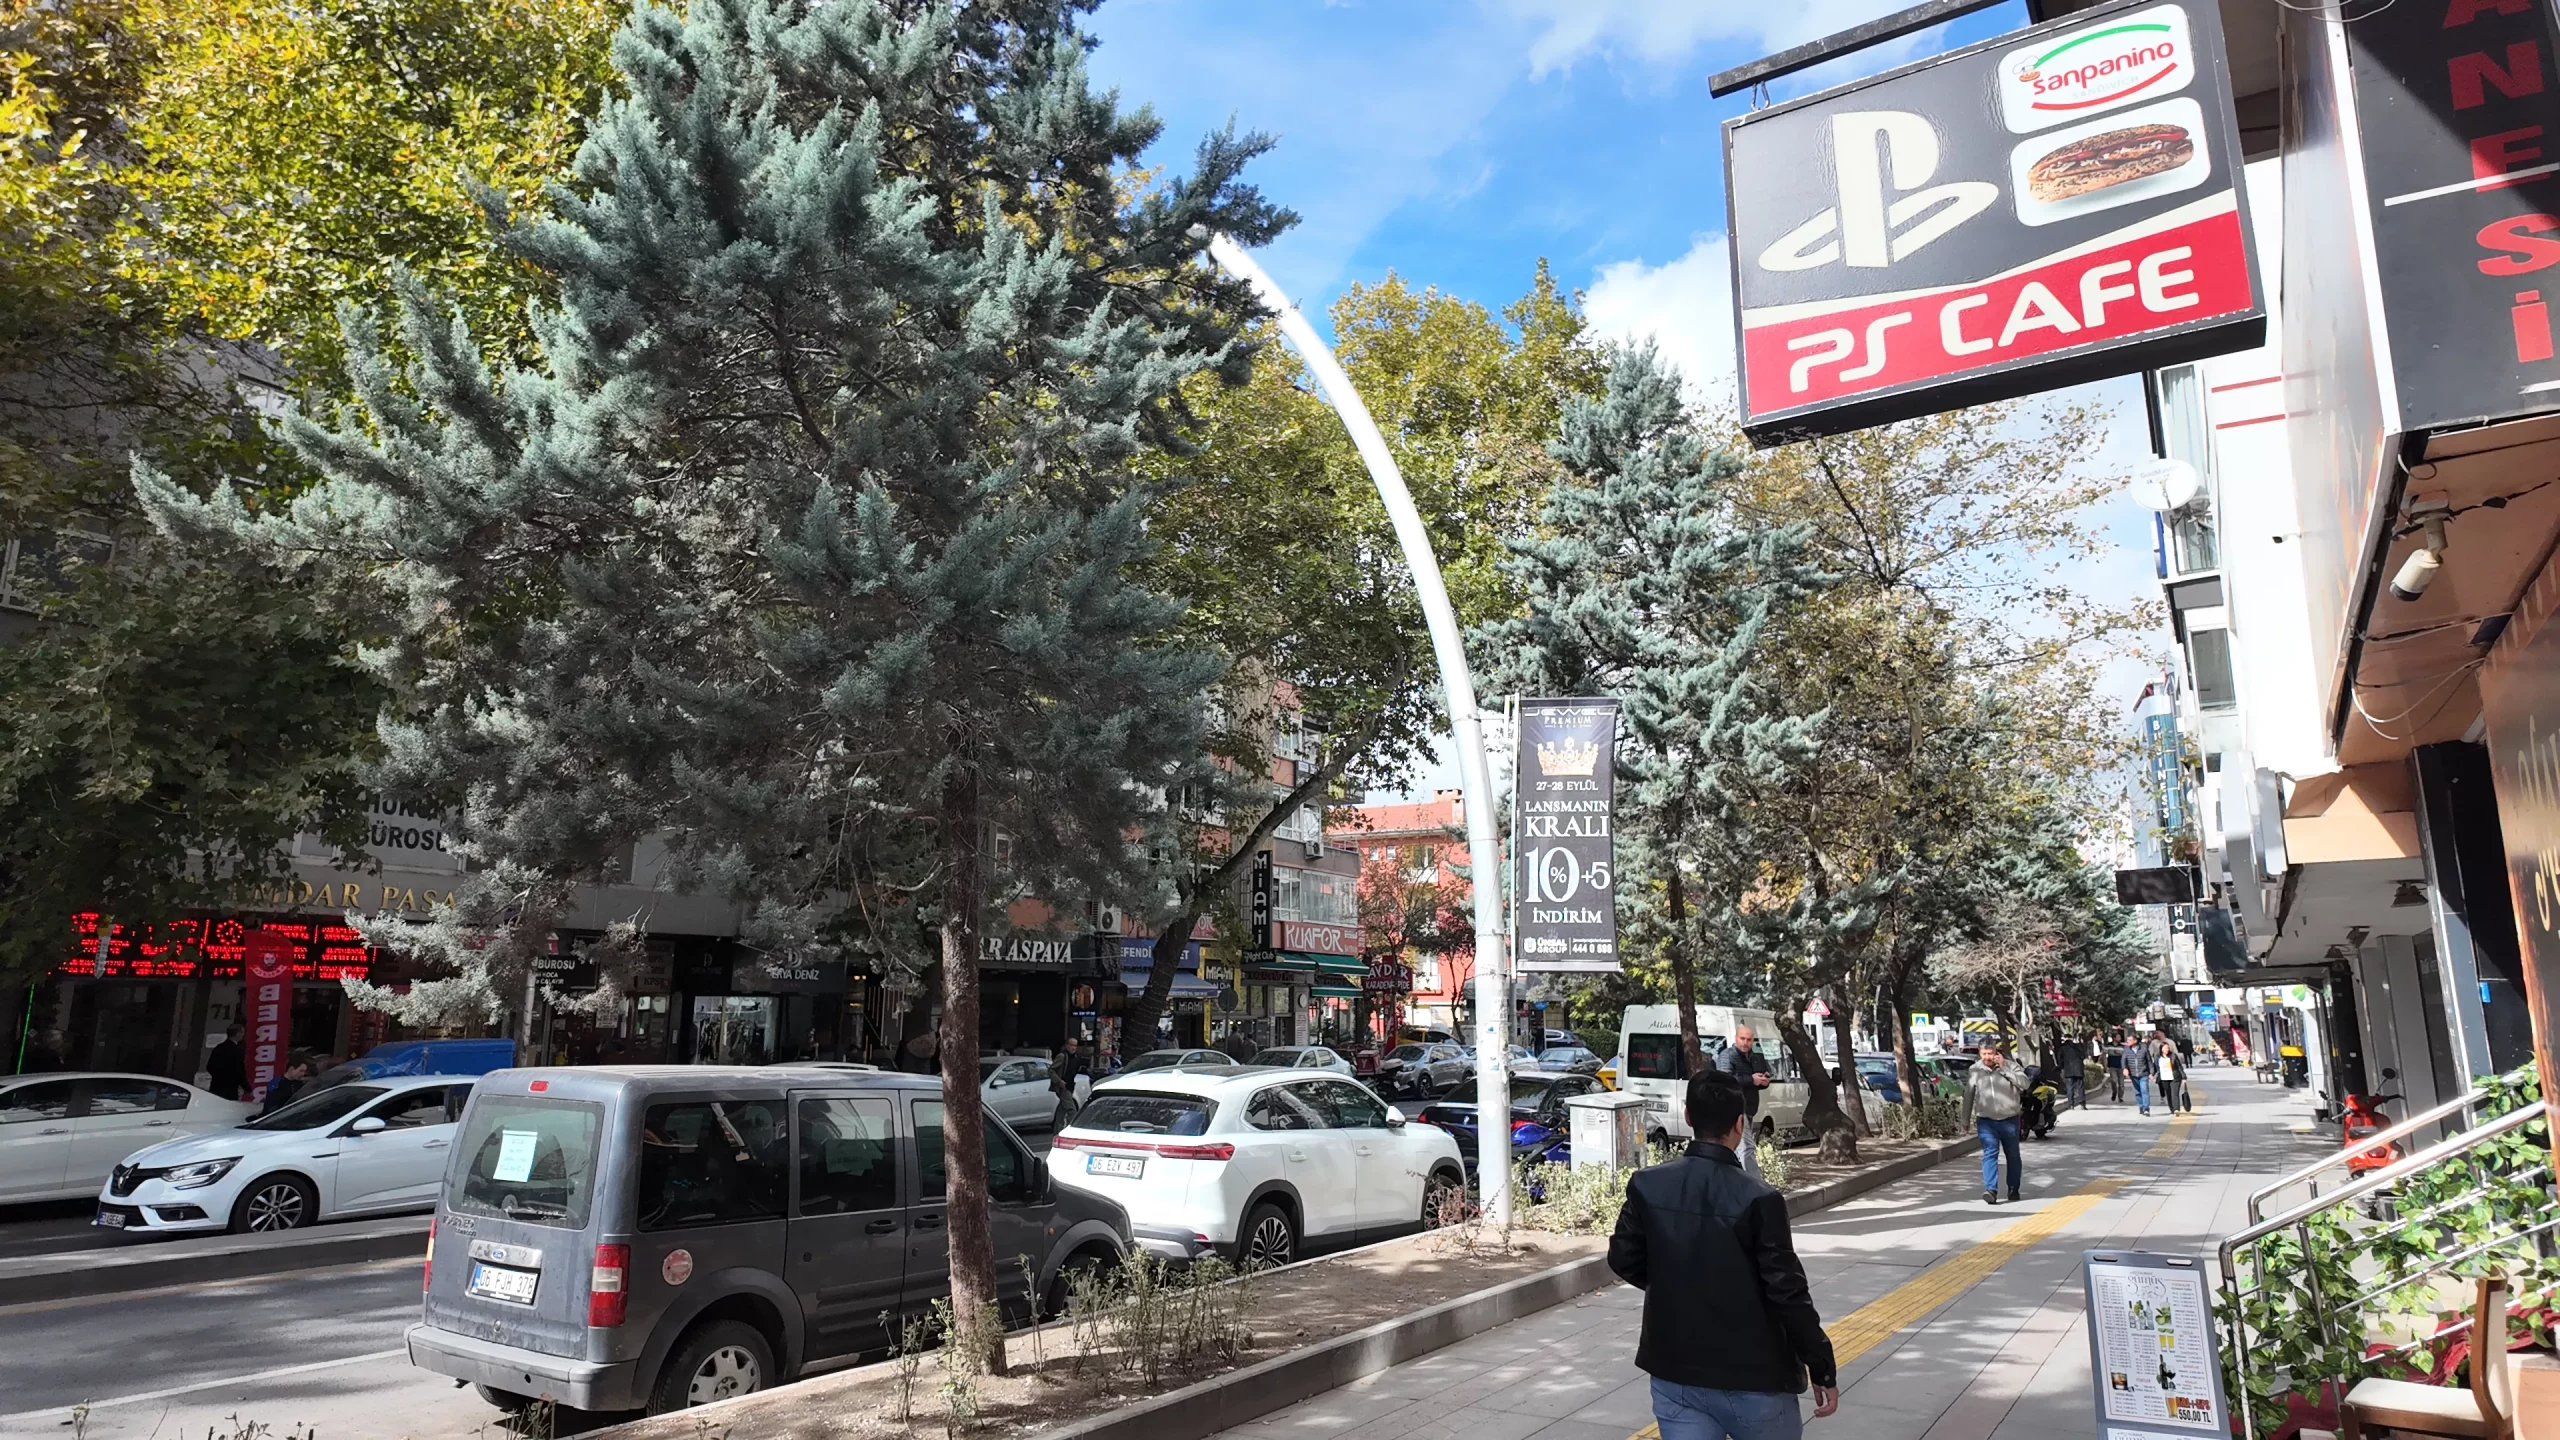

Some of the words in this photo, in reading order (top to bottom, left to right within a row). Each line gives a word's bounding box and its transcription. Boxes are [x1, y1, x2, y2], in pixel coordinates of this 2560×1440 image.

[2033, 42, 2175, 96] sanpanino
[2072, 75, 2140, 100] SANDWICH
[1787, 311, 1912, 393] PS
[1939, 245, 2200, 357] CAFE
[1524, 708, 1614, 717] JEWEL
[1544, 716, 1593, 725] PREMIUM
[1536, 781, 1564, 791] 27-28
[1566, 779, 1599, 791] EYLÜL
[1525, 801, 1610, 813] LANSMANIN
[1525, 815, 1610, 838] KRALI
[1524, 846, 1580, 903] 10
[1581, 861, 1611, 890] +5
[1532, 906, 1603, 924] İNDİRİM
[1006, 938, 1073, 964] ASPAVA
[1537, 946, 1568, 954] GROUP
[795, 968, 820, 981] DENİZ
[211, 1003, 232, 1020] 71
[1091, 1159, 1104, 1170] 06
[1126, 1162, 1142, 1174] 497
[480, 1269, 492, 1288] 06
[516, 1276, 535, 1296] 378
[2202, 1411, 2212, 1423] TL
